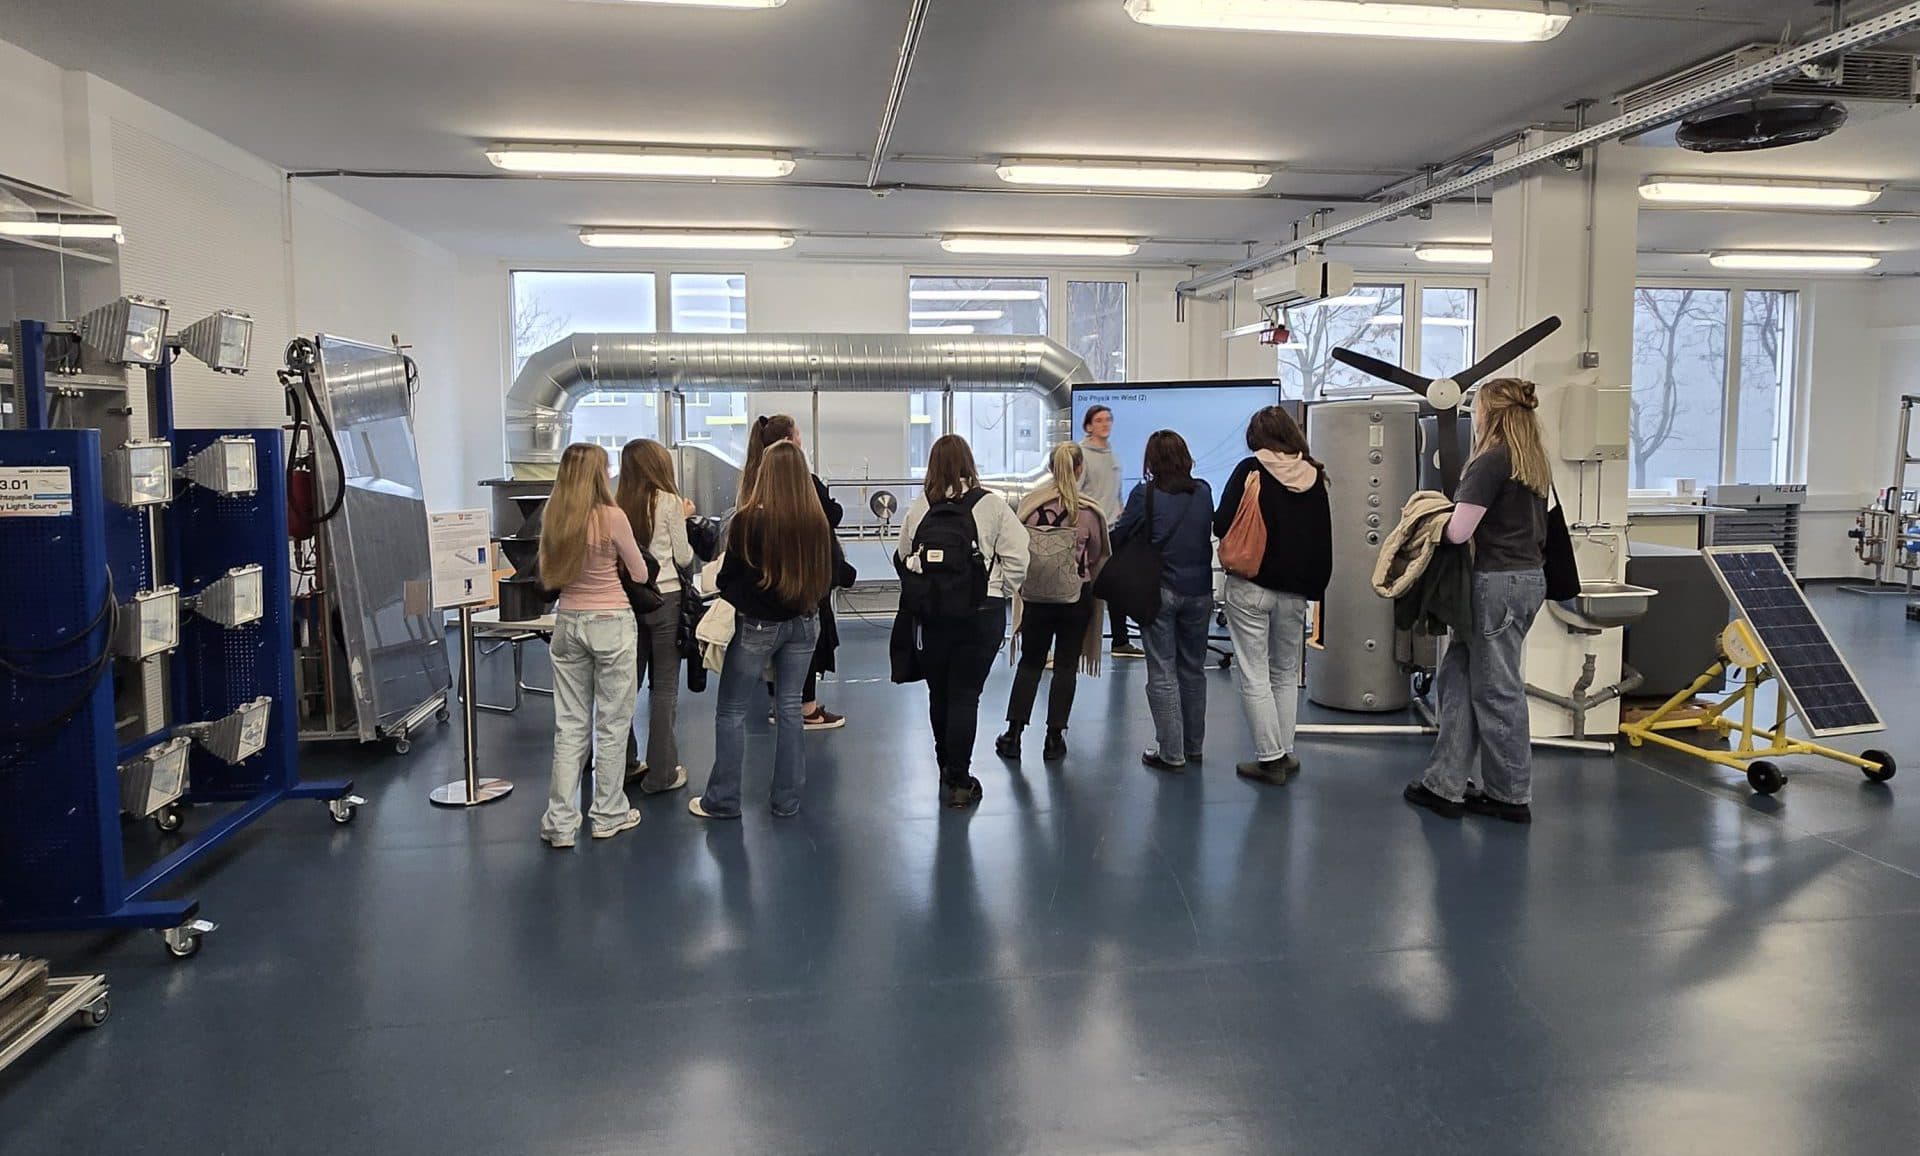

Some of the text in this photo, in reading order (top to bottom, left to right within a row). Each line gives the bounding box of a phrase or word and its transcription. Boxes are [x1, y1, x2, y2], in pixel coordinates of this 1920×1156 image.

[1089, 394, 1110, 403] Physik
[1139, 394, 1147, 402] (2)
[1775, 485, 1807, 493] HELLA
